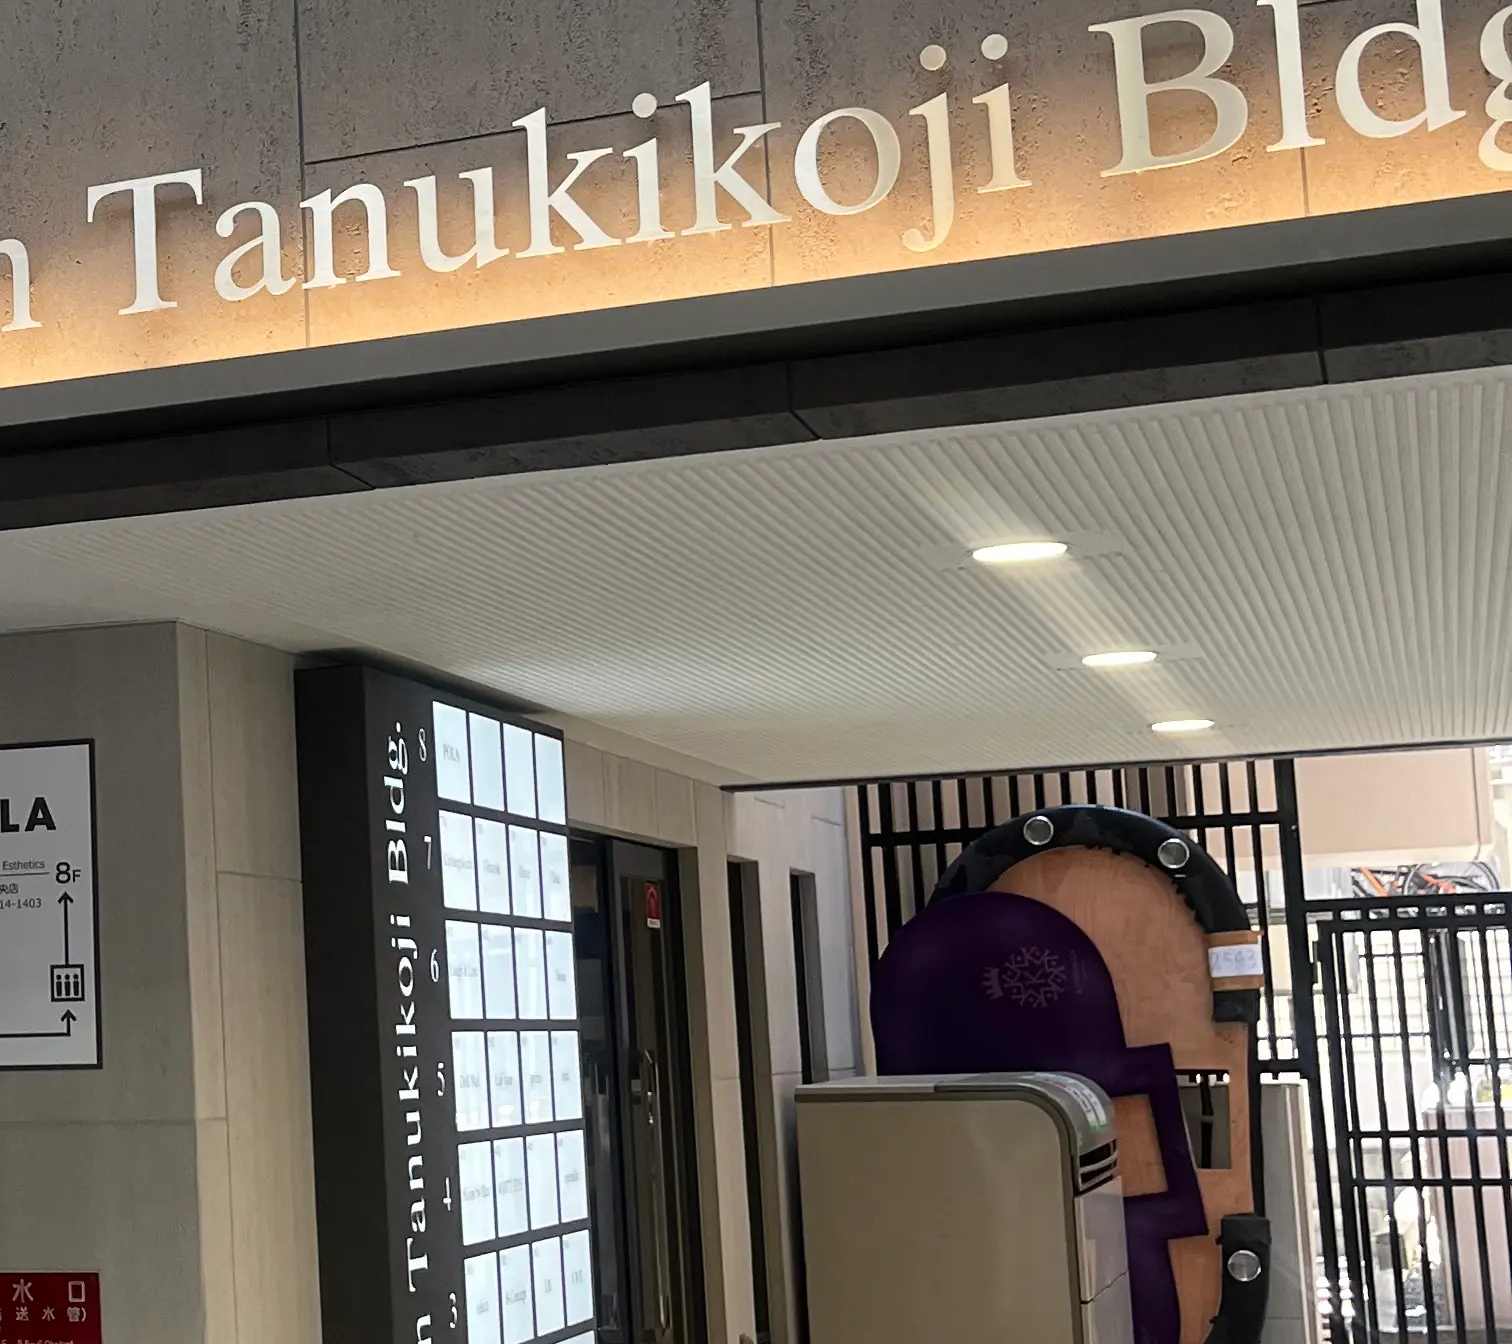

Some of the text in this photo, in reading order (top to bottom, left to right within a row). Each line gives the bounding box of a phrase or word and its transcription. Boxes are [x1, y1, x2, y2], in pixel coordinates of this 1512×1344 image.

[87, 33, 1033, 316] Tanukikoji
[418, 728, 427, 762] 8
[384, 722, 409, 885] Bldg.
[2, 859, 46, 871] Esthetics
[424, 835, 432, 870] 7
[55, 861, 82, 885] 8F
[430, 948, 440, 983] 6
[390, 913, 429, 1293] Tanukikoji
